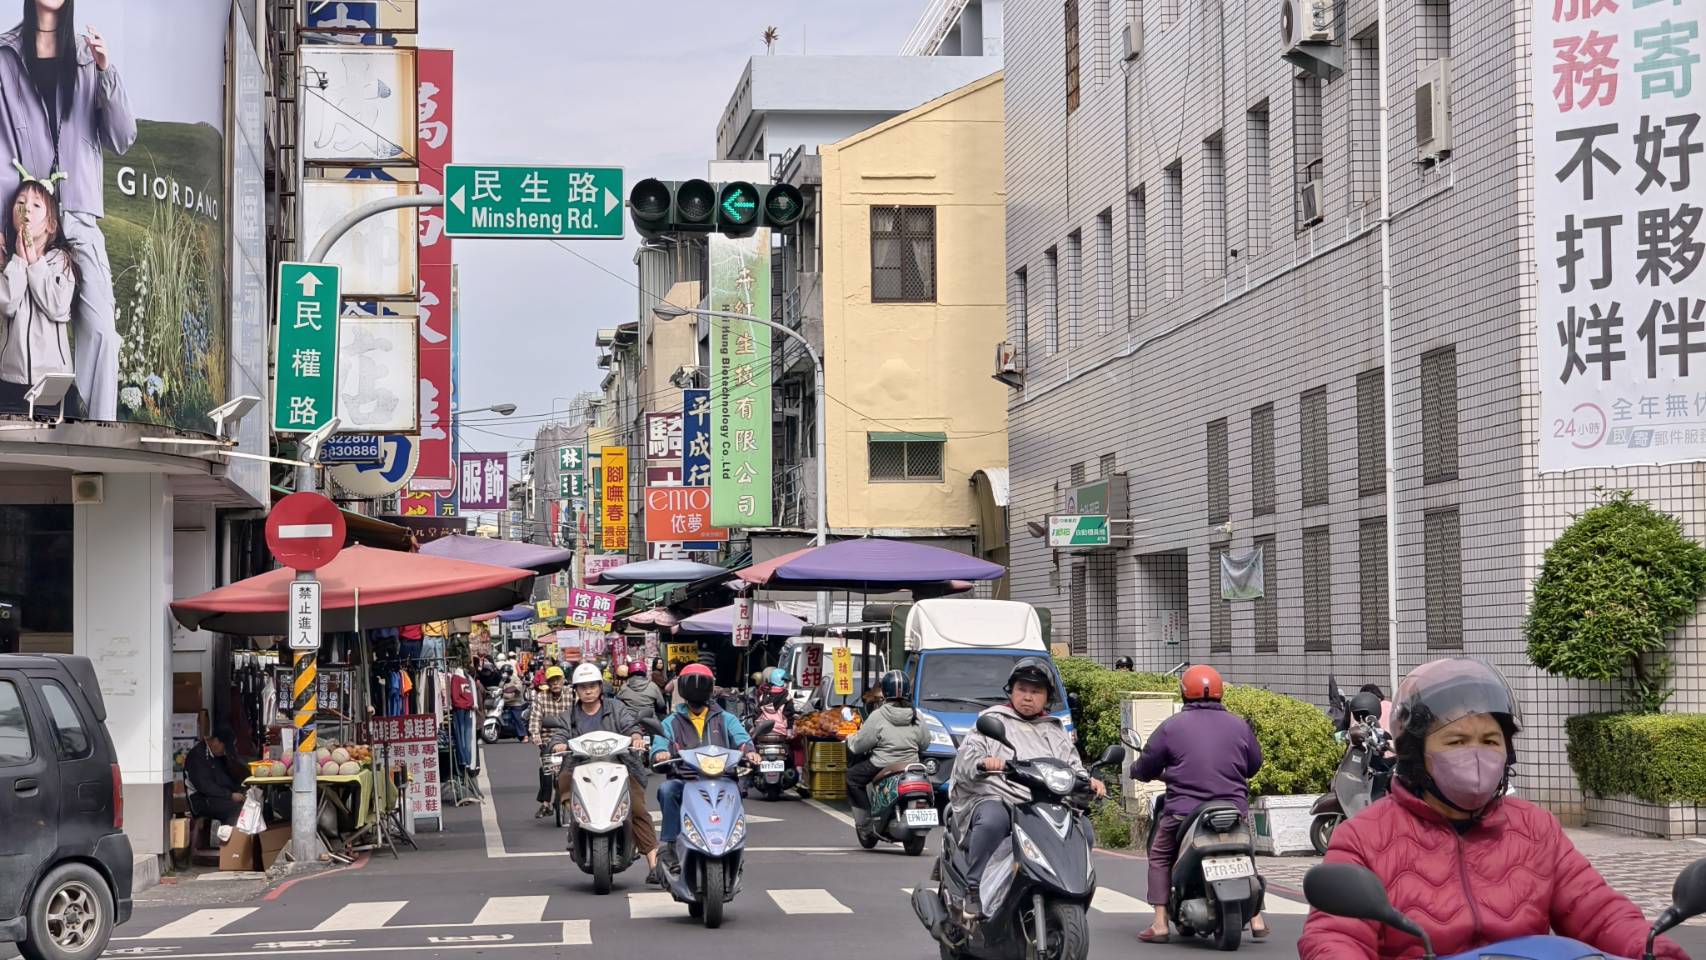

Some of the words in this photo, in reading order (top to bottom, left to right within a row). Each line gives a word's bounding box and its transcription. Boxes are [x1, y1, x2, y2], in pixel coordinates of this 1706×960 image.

[117, 166, 219, 222] GIORDANO
[471, 170, 599, 204] 民生路
[1552, 0, 1626, 385] 務不打烊
[1632, 0, 1706, 380] 寄好夥伴
[471, 207, 562, 234] Minsheng
[568, 208, 599, 229] Rd.
[289, 301, 323, 425] 民權路
[720, 357, 732, 438] Biotechnology
[461, 458, 504, 504] 服飾
[649, 489, 710, 511] emo
[671, 513, 703, 535] 依夢
[298, 586, 312, 645] 禁止進入
